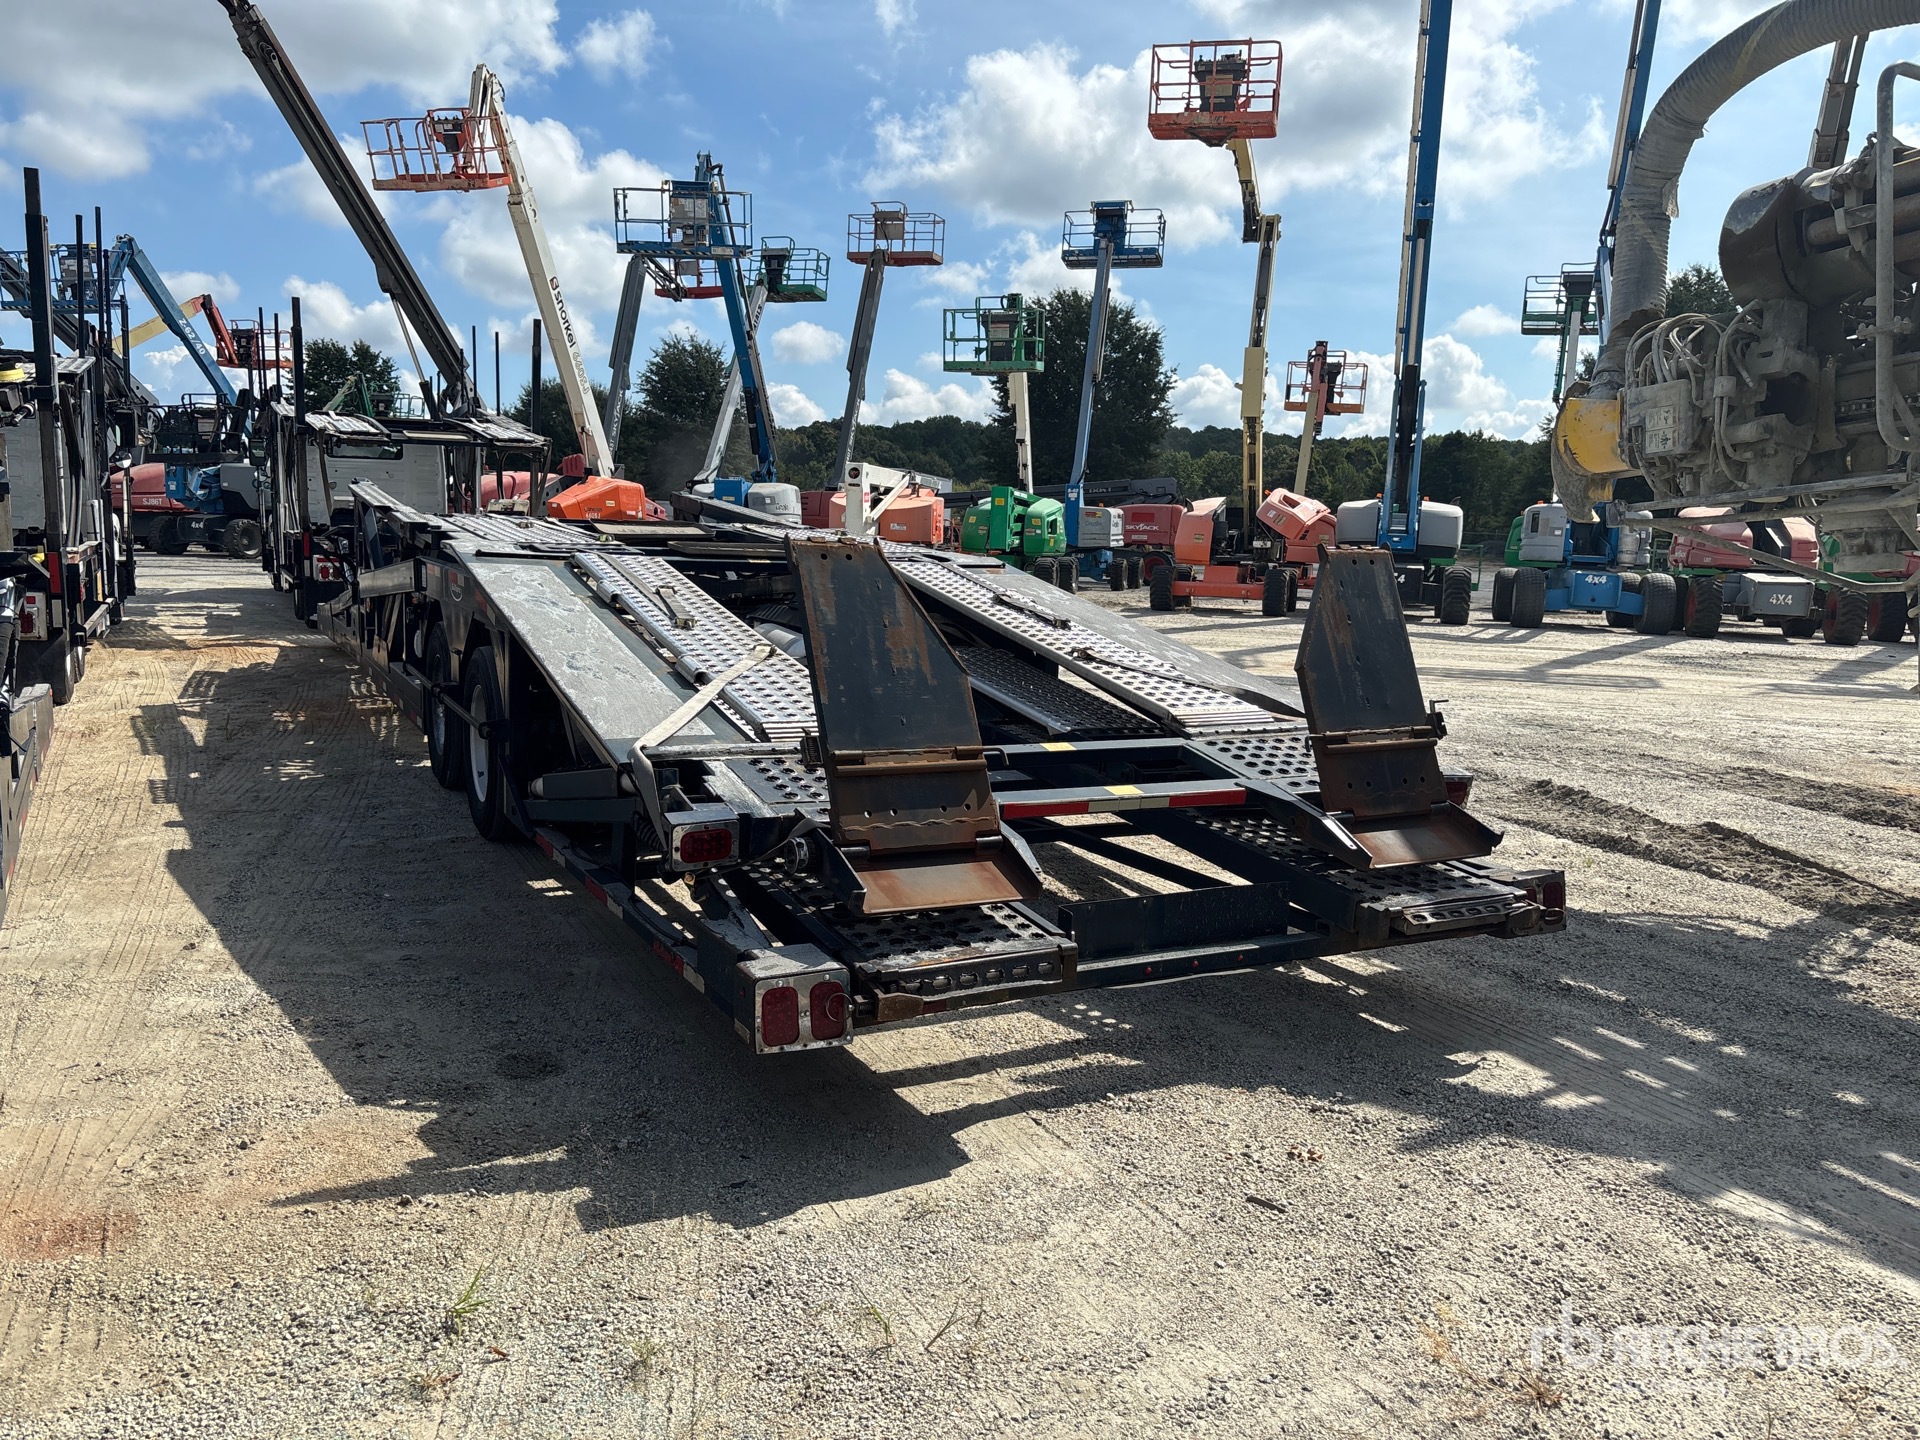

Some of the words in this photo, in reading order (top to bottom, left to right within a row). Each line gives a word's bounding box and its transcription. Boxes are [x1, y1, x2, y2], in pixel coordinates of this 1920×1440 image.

[554, 291, 577, 348] snorkel
[178, 318, 206, 355] Z-62/40
[142, 498, 163, 506] SJ86T
[191, 521, 204, 530] 4x4
[1125, 523, 1160, 531] SKYJACK
[1585, 574, 1607, 584] 4x4
[1769, 593, 1793, 605] 4X4
